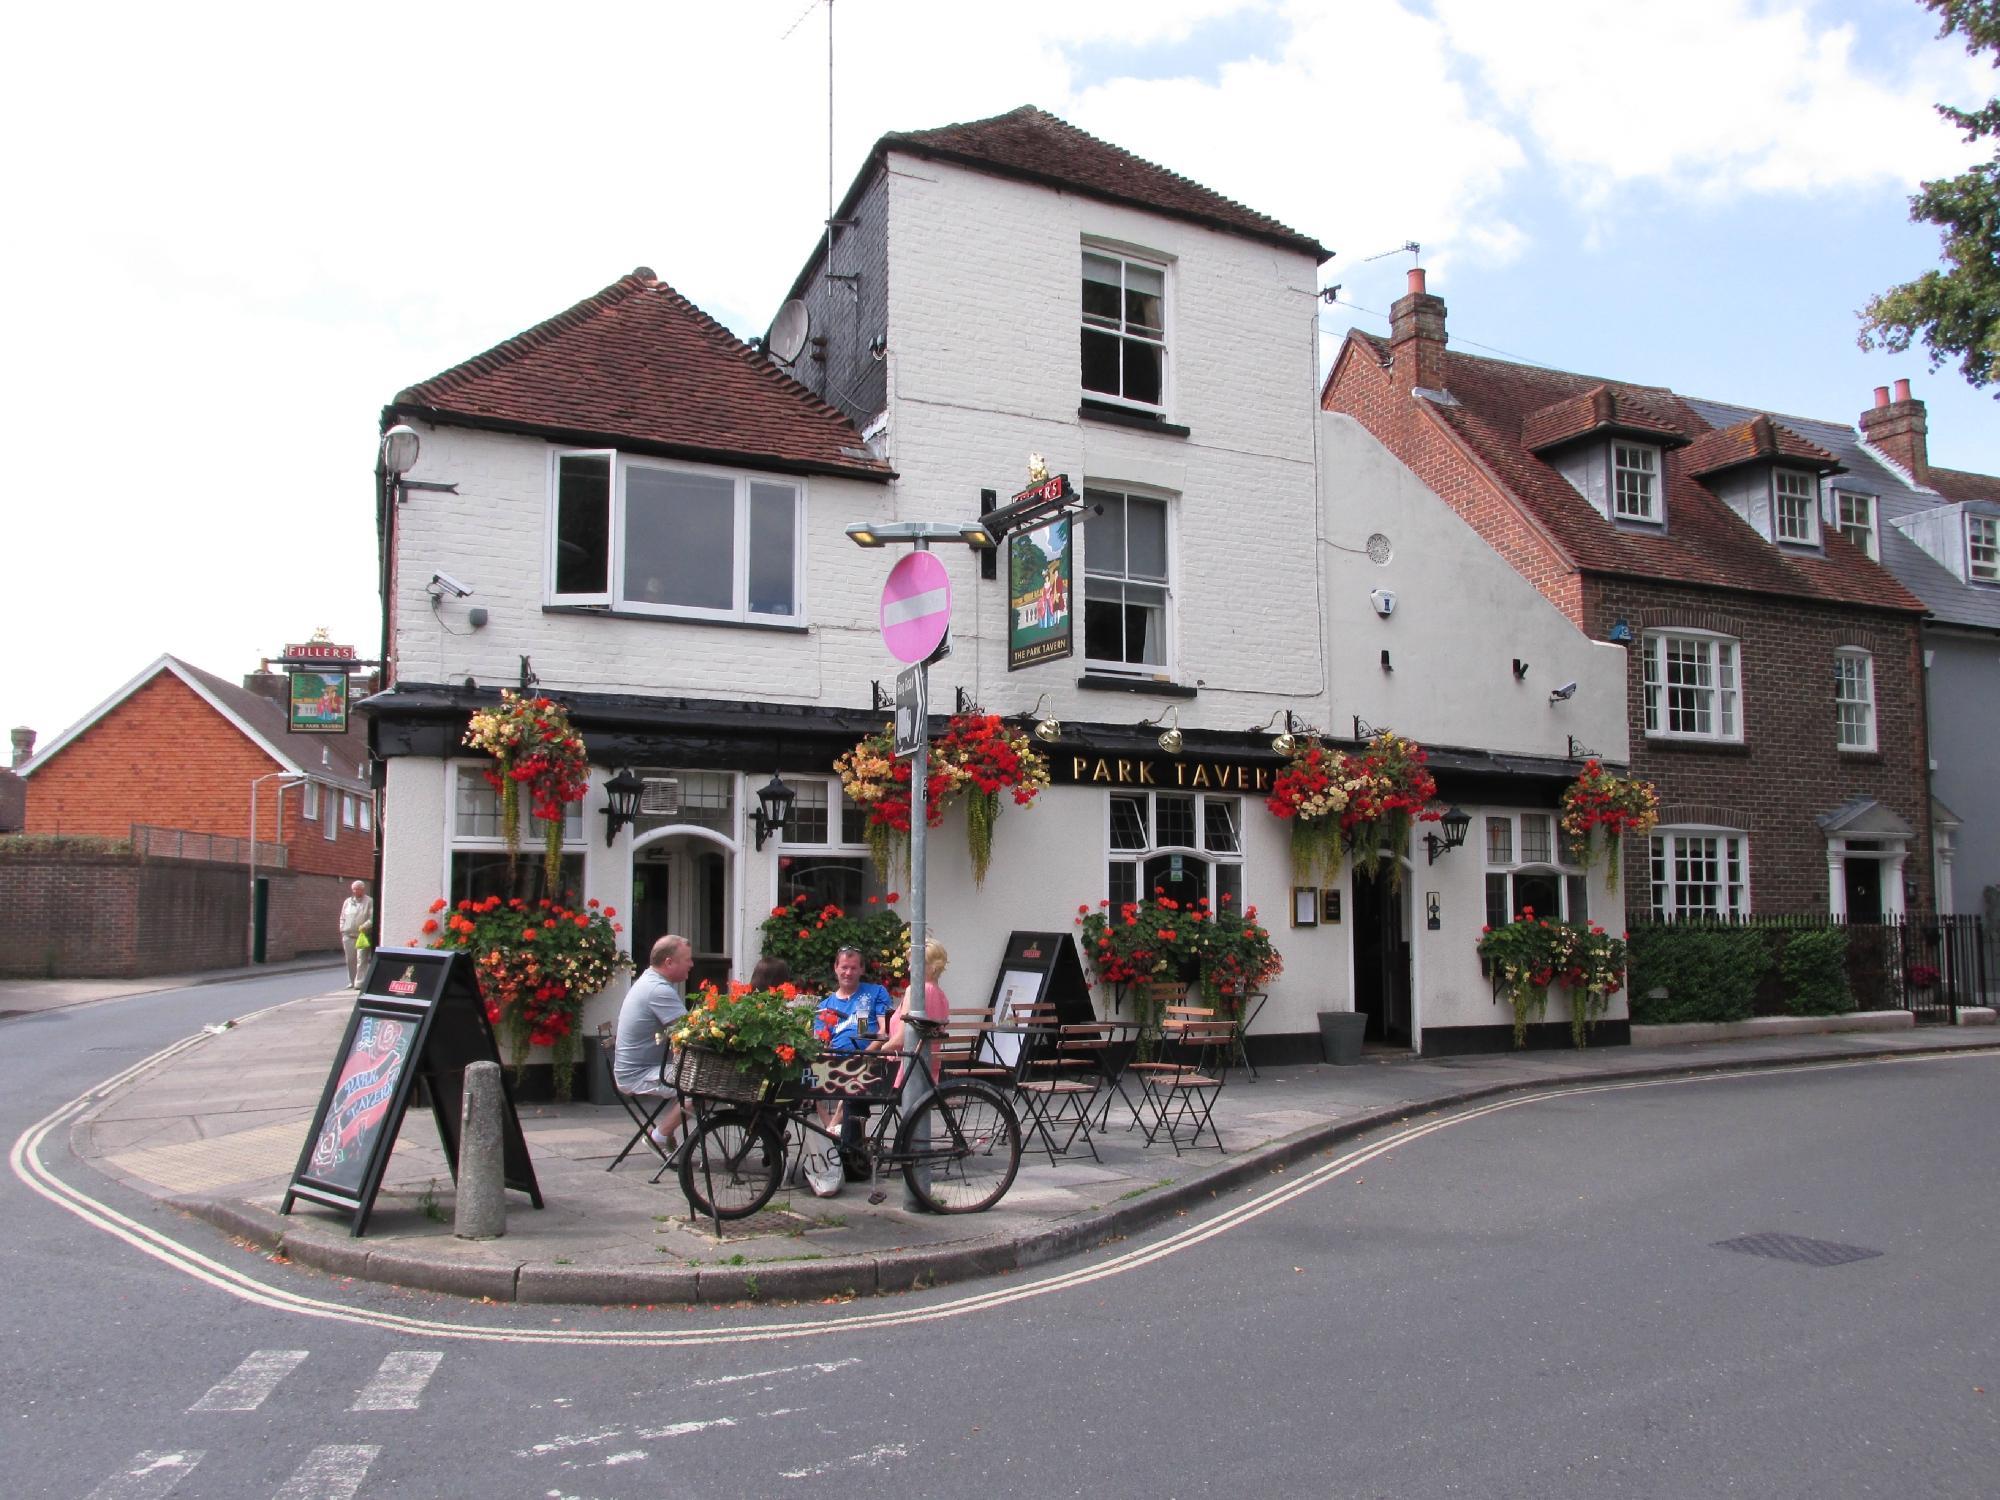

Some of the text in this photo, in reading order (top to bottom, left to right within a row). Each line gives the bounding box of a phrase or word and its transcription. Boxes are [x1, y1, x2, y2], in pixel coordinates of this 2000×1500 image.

[1015, 639, 1067, 661] THE PARK TAVERN
[1073, 756, 1155, 785] PARK
[1174, 763, 1280, 791] TAVER
